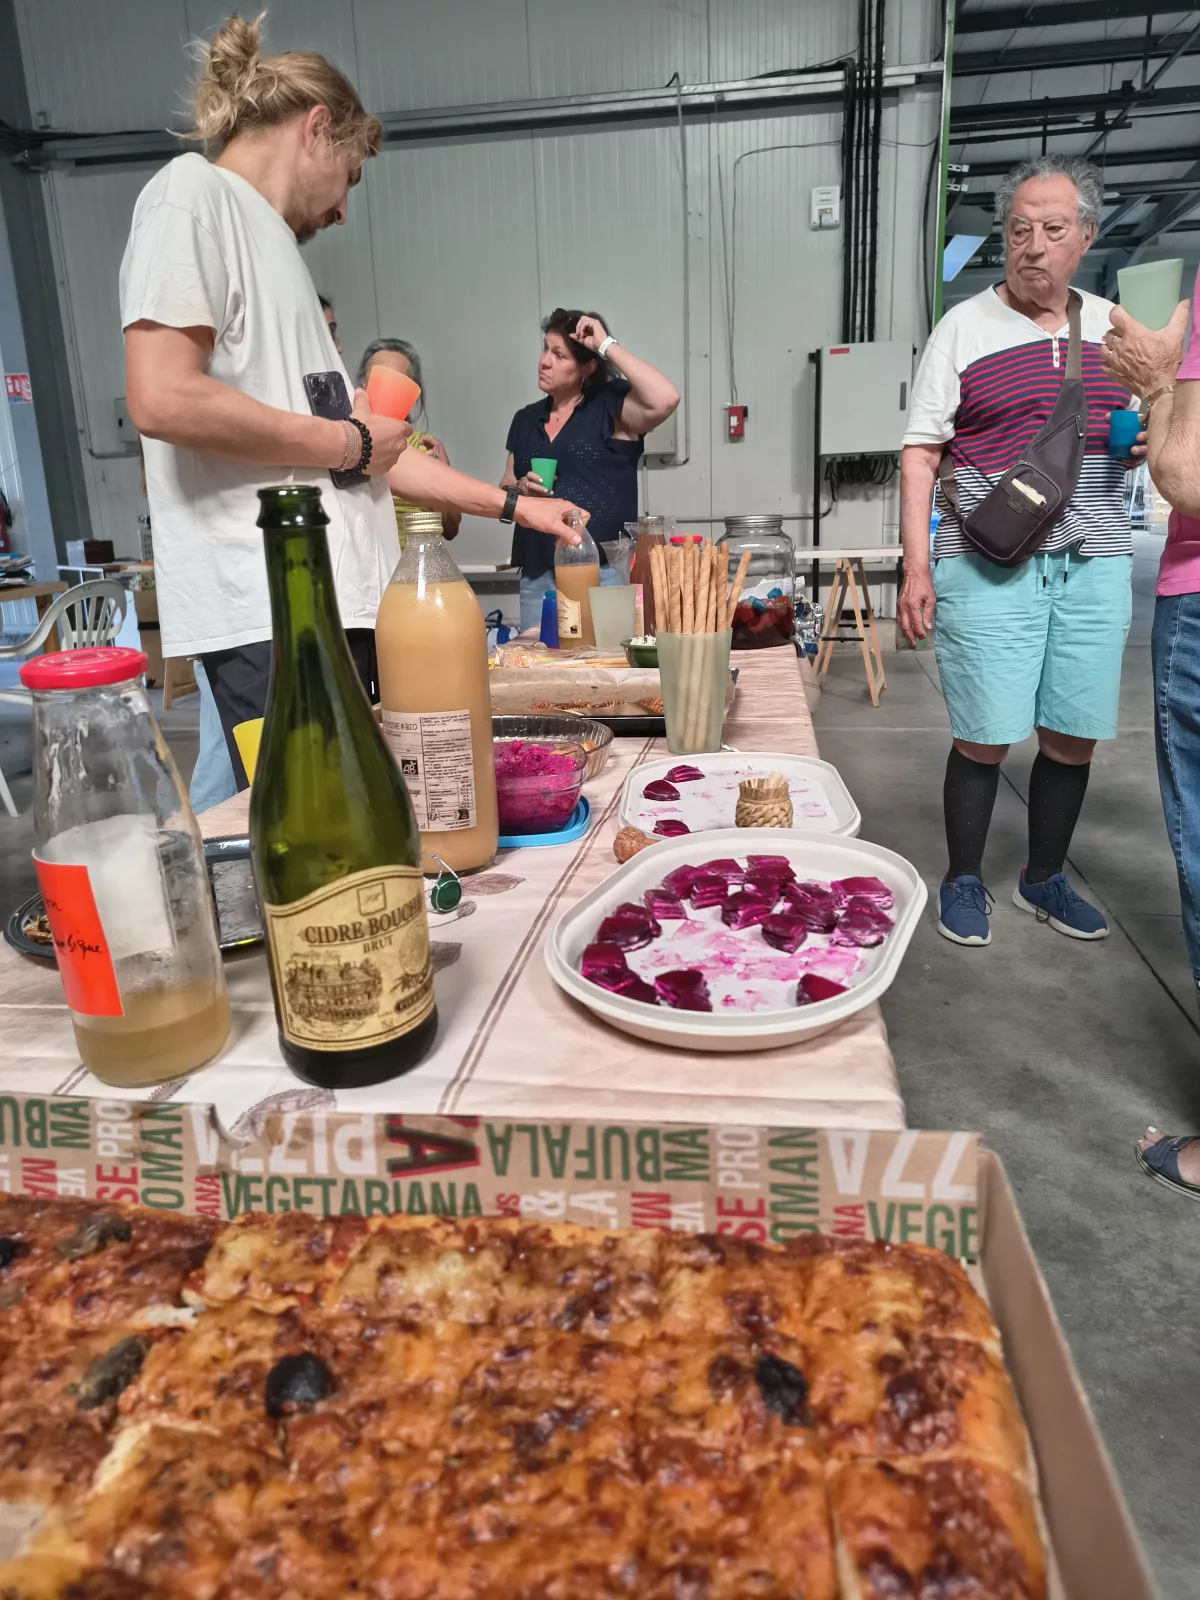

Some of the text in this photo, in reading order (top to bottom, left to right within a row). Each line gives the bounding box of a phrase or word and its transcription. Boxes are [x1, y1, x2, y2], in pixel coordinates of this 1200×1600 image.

[406, 723, 418, 731] BIO
[305, 921, 365, 944] CIDRE
[363, 935, 394, 953] BRUT
[485, 1122, 662, 1183] BUFALA
[221, 1171, 484, 1221] VEGETARIANA
